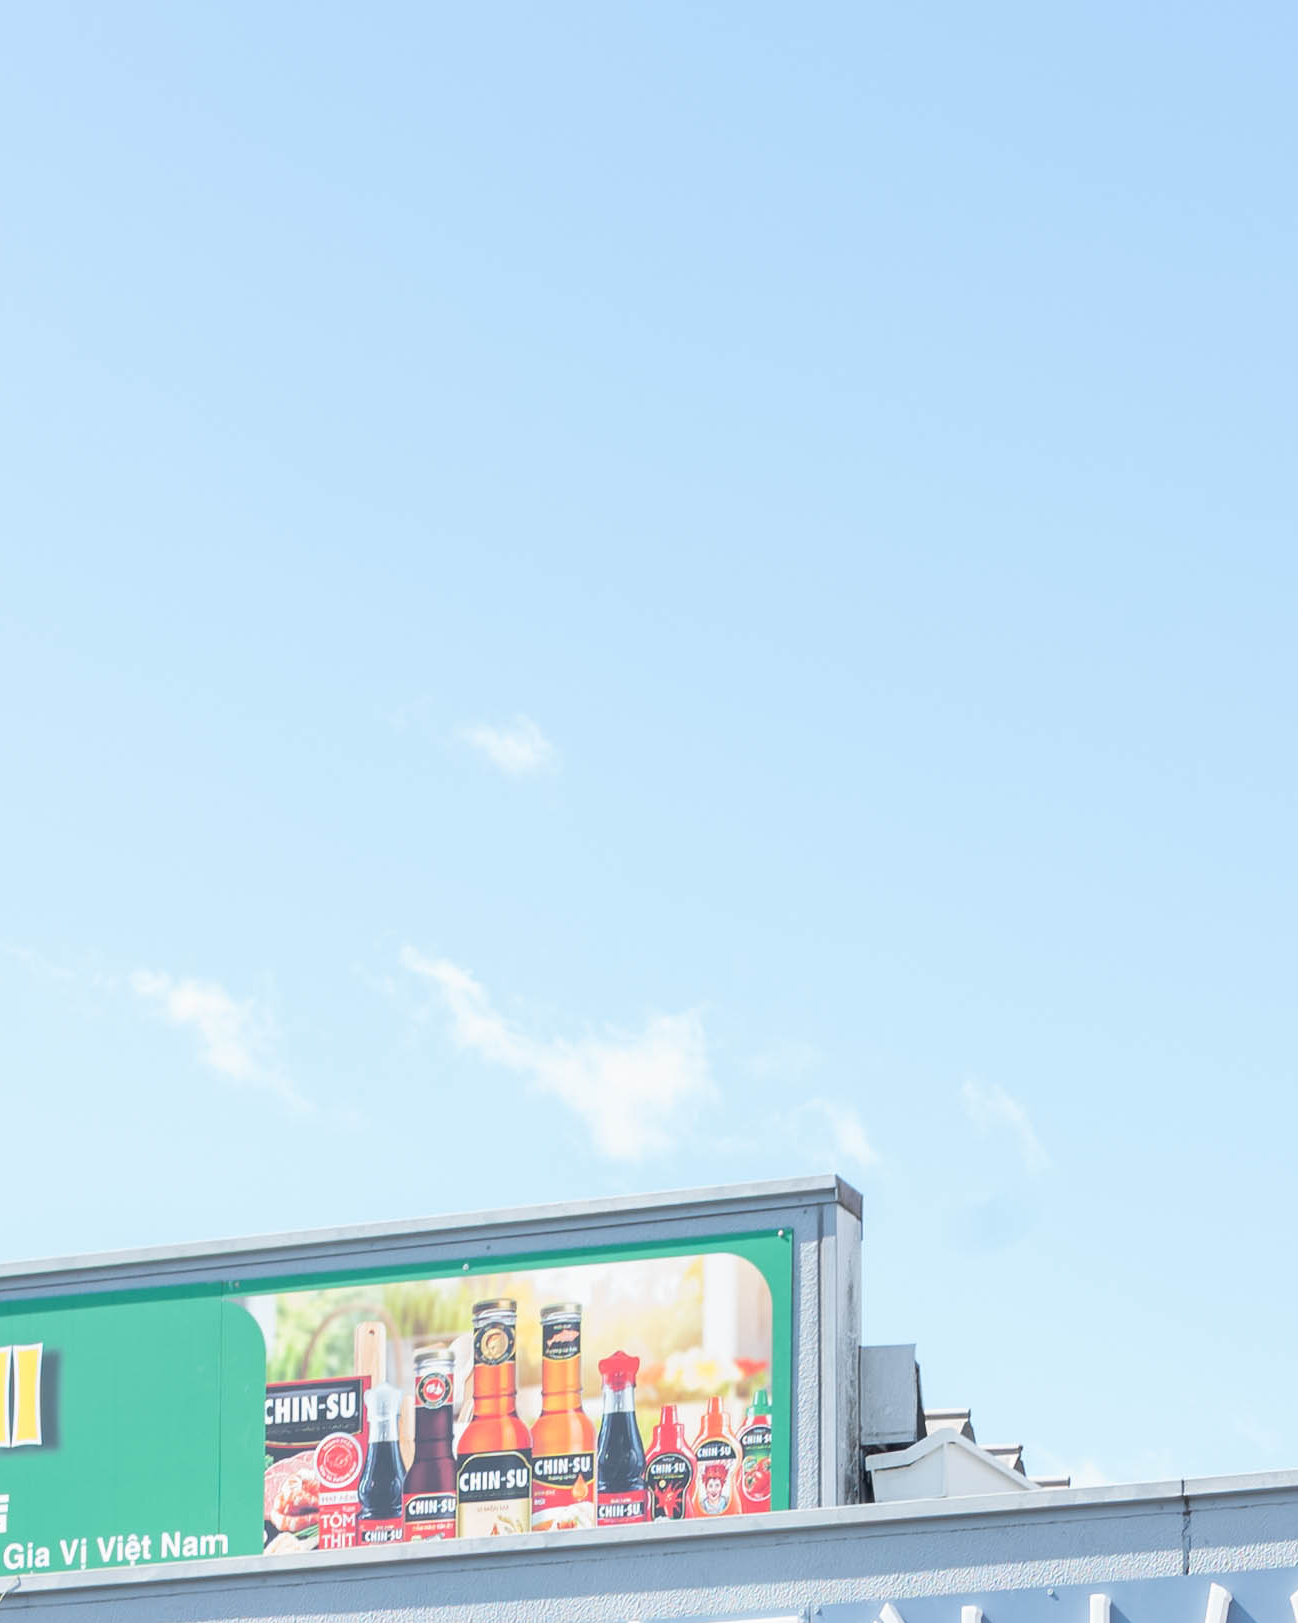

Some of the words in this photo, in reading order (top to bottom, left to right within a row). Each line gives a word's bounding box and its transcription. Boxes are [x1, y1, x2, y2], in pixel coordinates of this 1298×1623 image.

[264, 1392, 358, 1425] CHIN-SU
[697, 1446, 731, 1458] CHIN-SU
[533, 1458, 592, 1476] CHIN-SU
[651, 1462, 686, 1475] CHIN-SU
[459, 1469, 530, 1492] CHIN-SU
[408, 1498, 457, 1516] CHIN-SU
[598, 1503, 642, 1519] CHIN-SU
[321, 1512, 356, 1529] TÔM
[364, 1528, 402, 1543] CHIN-SU
[3, 1543, 50, 1570] Gia
[60, 1539, 88, 1571] Vị
[97, 1535, 151, 1566] Việt
[161, 1530, 229, 1559] Nam
